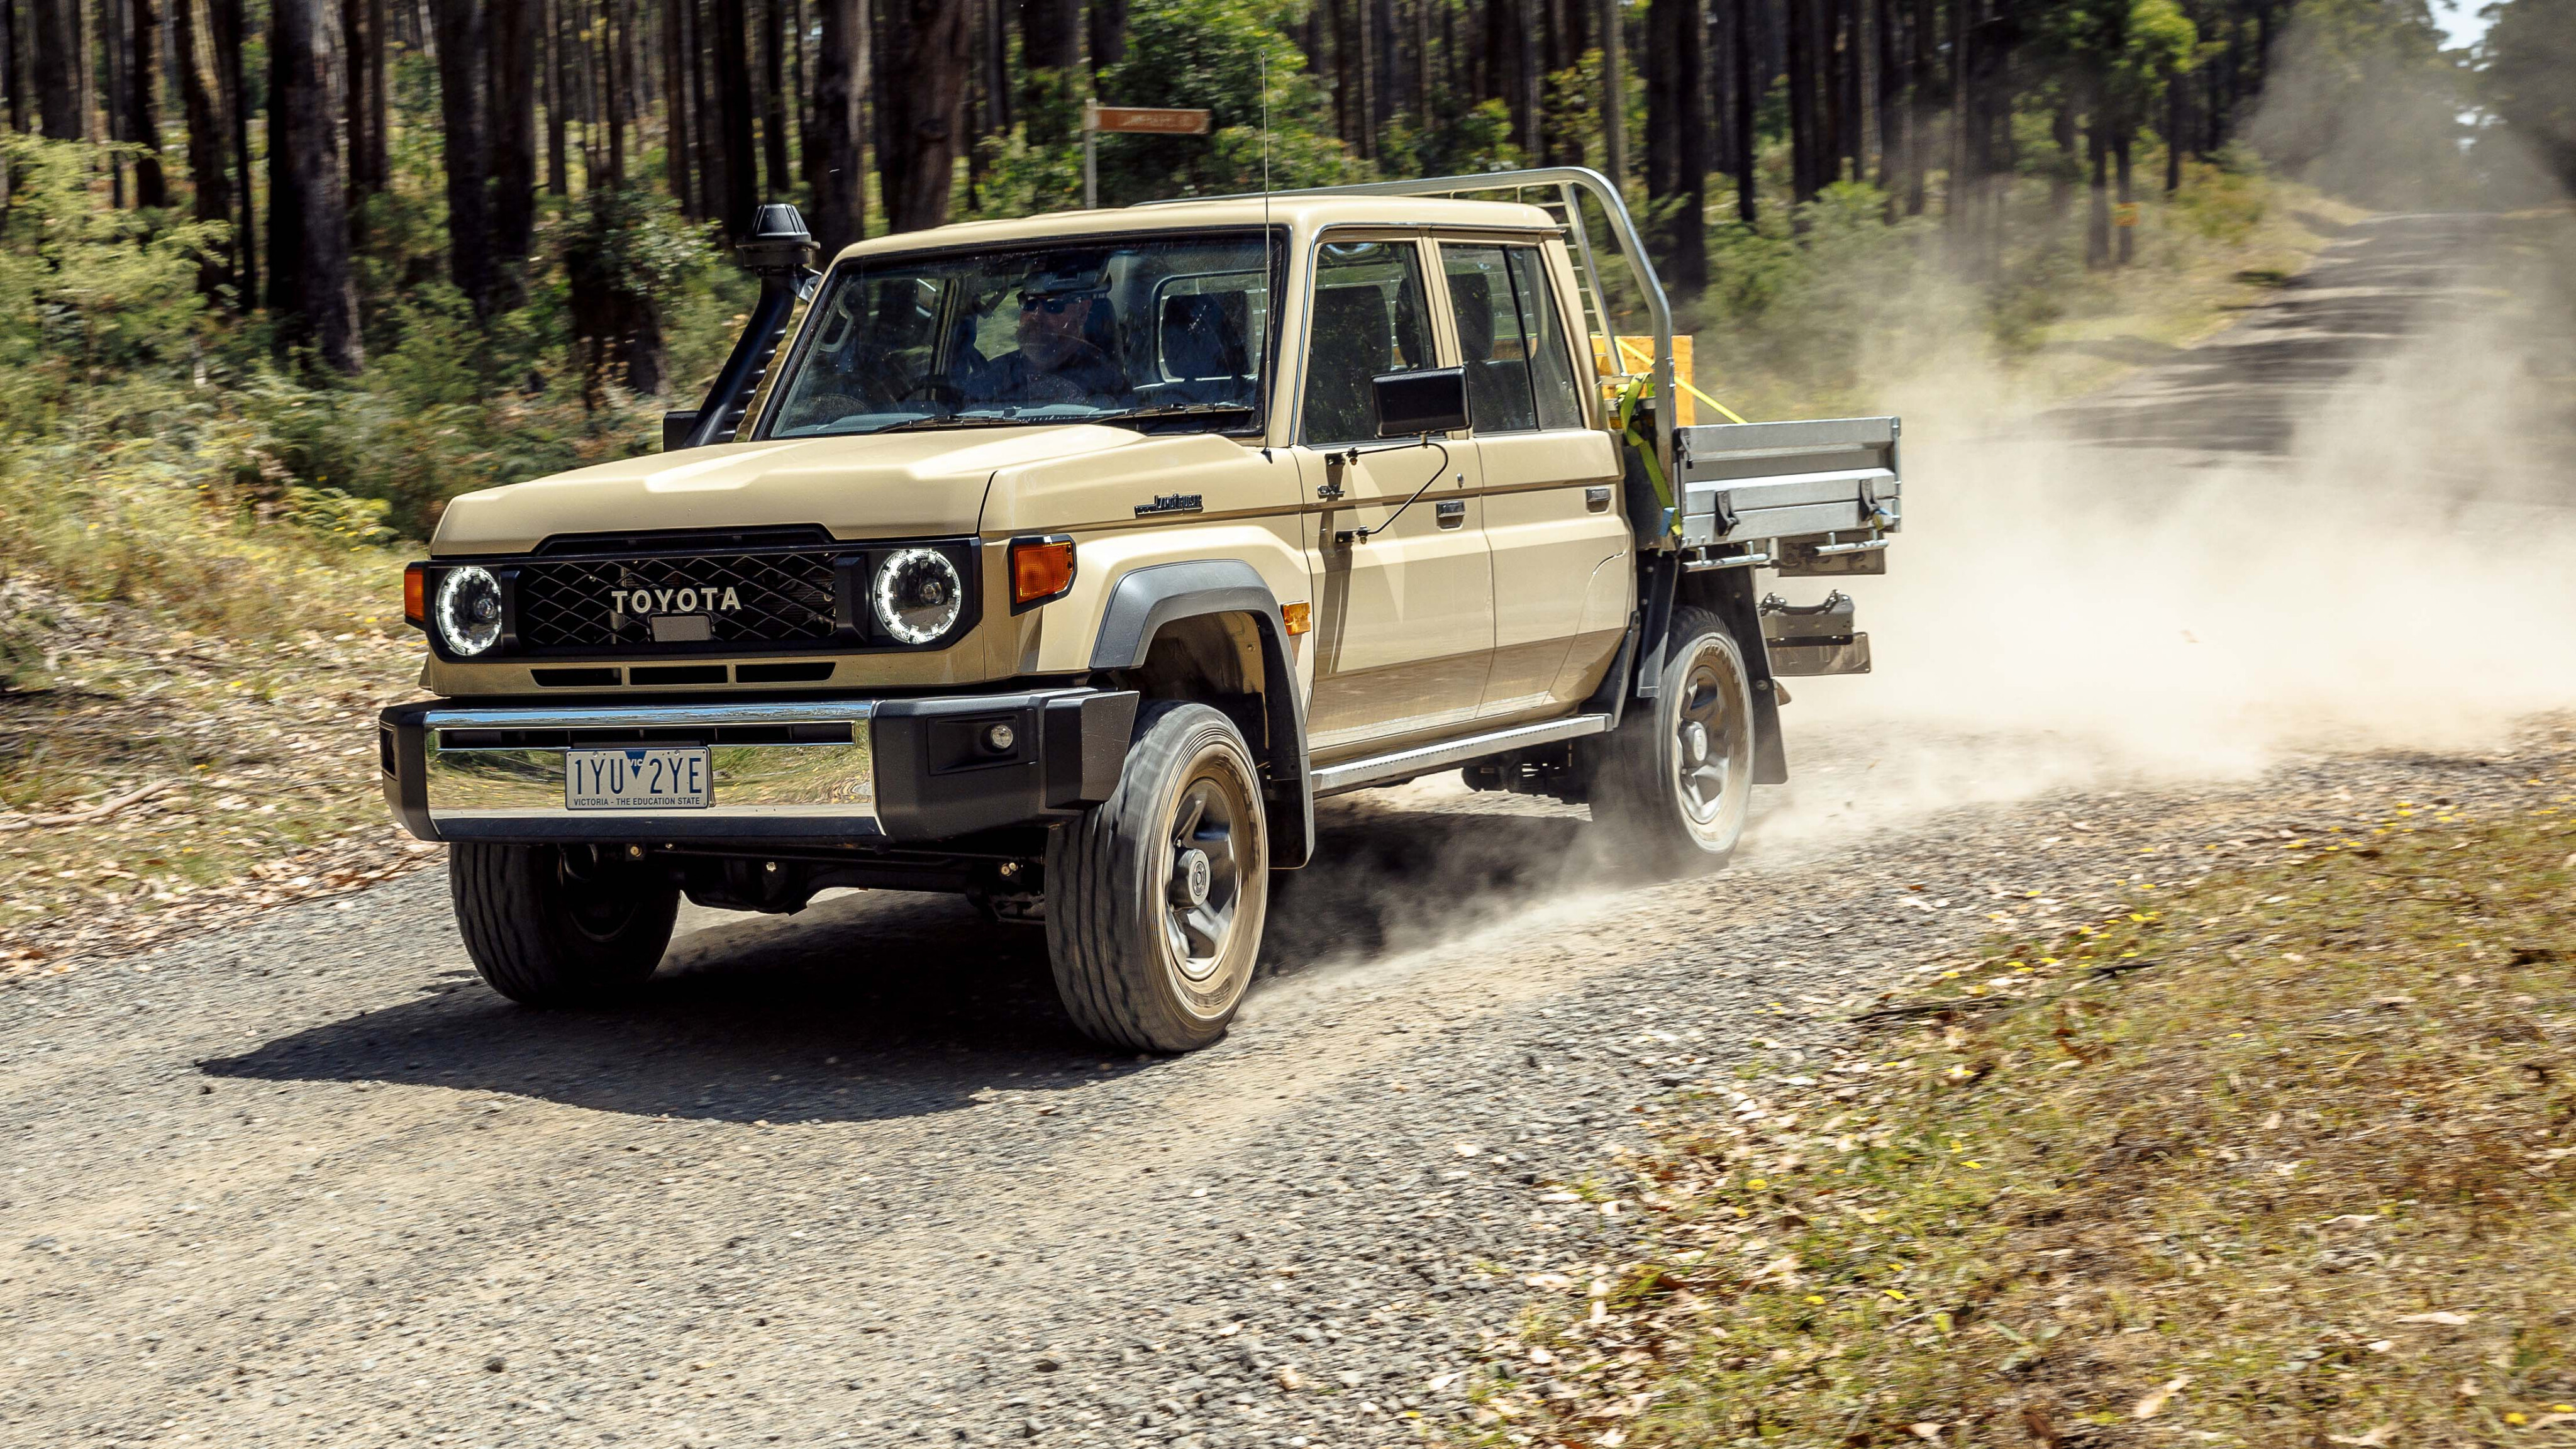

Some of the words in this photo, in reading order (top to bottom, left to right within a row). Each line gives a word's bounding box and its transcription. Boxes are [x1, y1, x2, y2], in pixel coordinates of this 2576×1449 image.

[611, 587, 741, 613] TOYOTA
[575, 758, 623, 794] 1YU
[649, 757, 702, 794] 2YE
